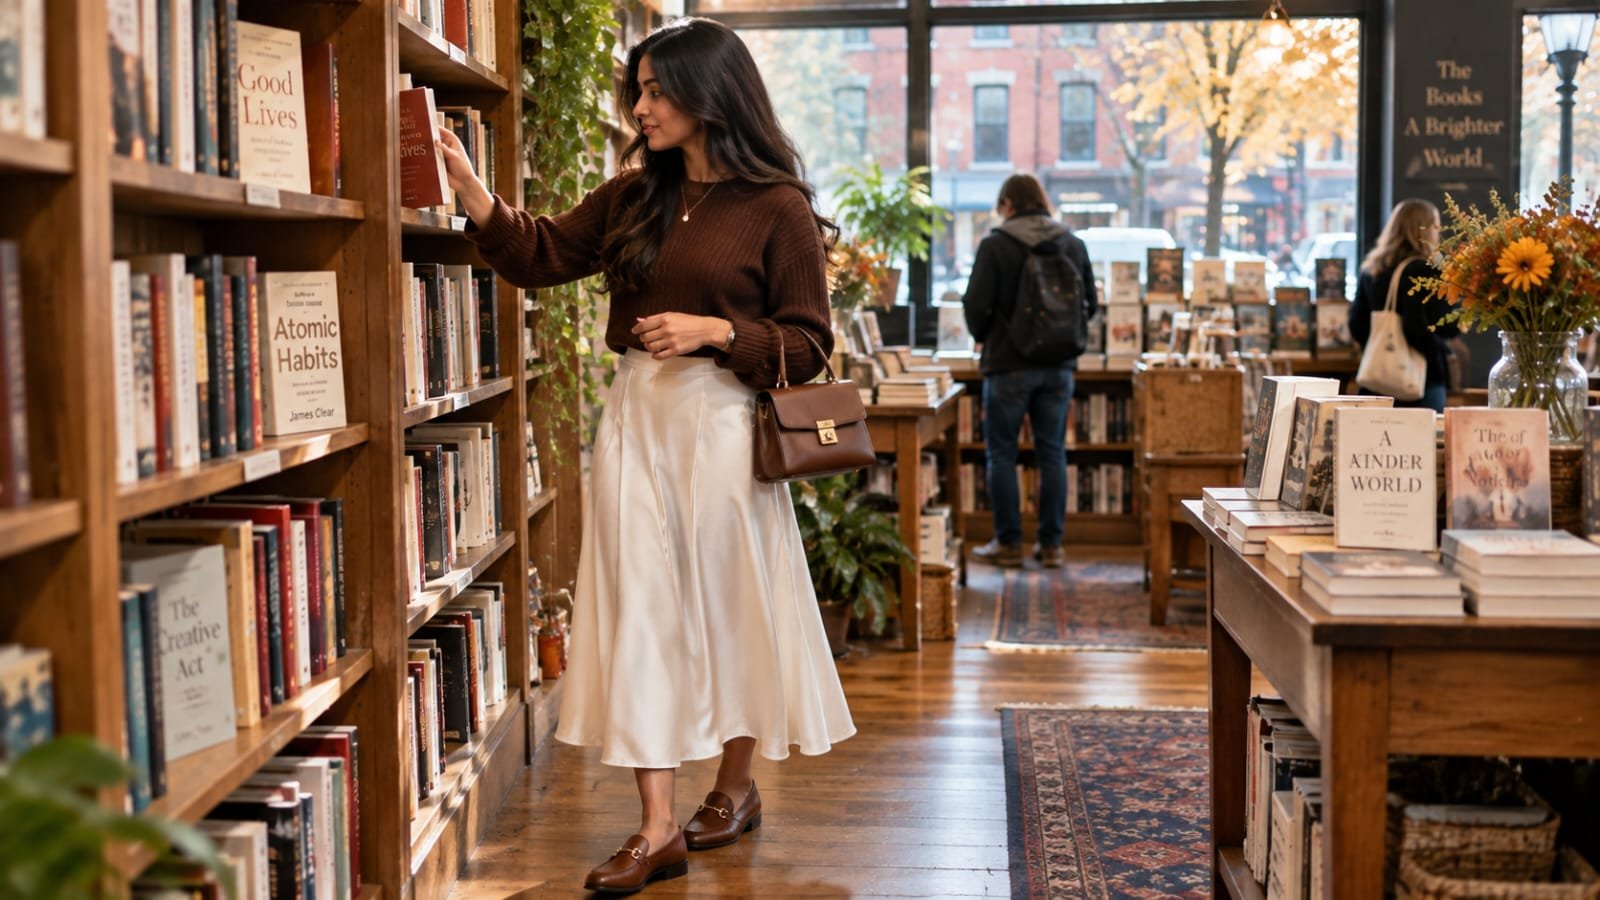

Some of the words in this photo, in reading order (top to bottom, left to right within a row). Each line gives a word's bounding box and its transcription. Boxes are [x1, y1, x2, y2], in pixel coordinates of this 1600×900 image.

[238, 62, 293, 96] Good
[1436, 60, 1472, 79] The
[1426, 85, 1483, 106] Books
[243, 96, 297, 129] Lives
[1404, 117, 1420, 136] A
[1425, 116, 1505, 140] Brighter
[1423, 146, 1483, 168] World
[274, 314, 337, 340] Atomic
[277, 345, 338, 373] Habits
[289, 409, 314, 422] James
[315, 407, 335, 418] Clear
[1379, 430, 1392, 447] A
[1350, 475, 1422, 493] WORLD
[168, 597, 200, 622] The
[159, 620, 221, 655] Creative
[176, 654, 204, 681] Act
